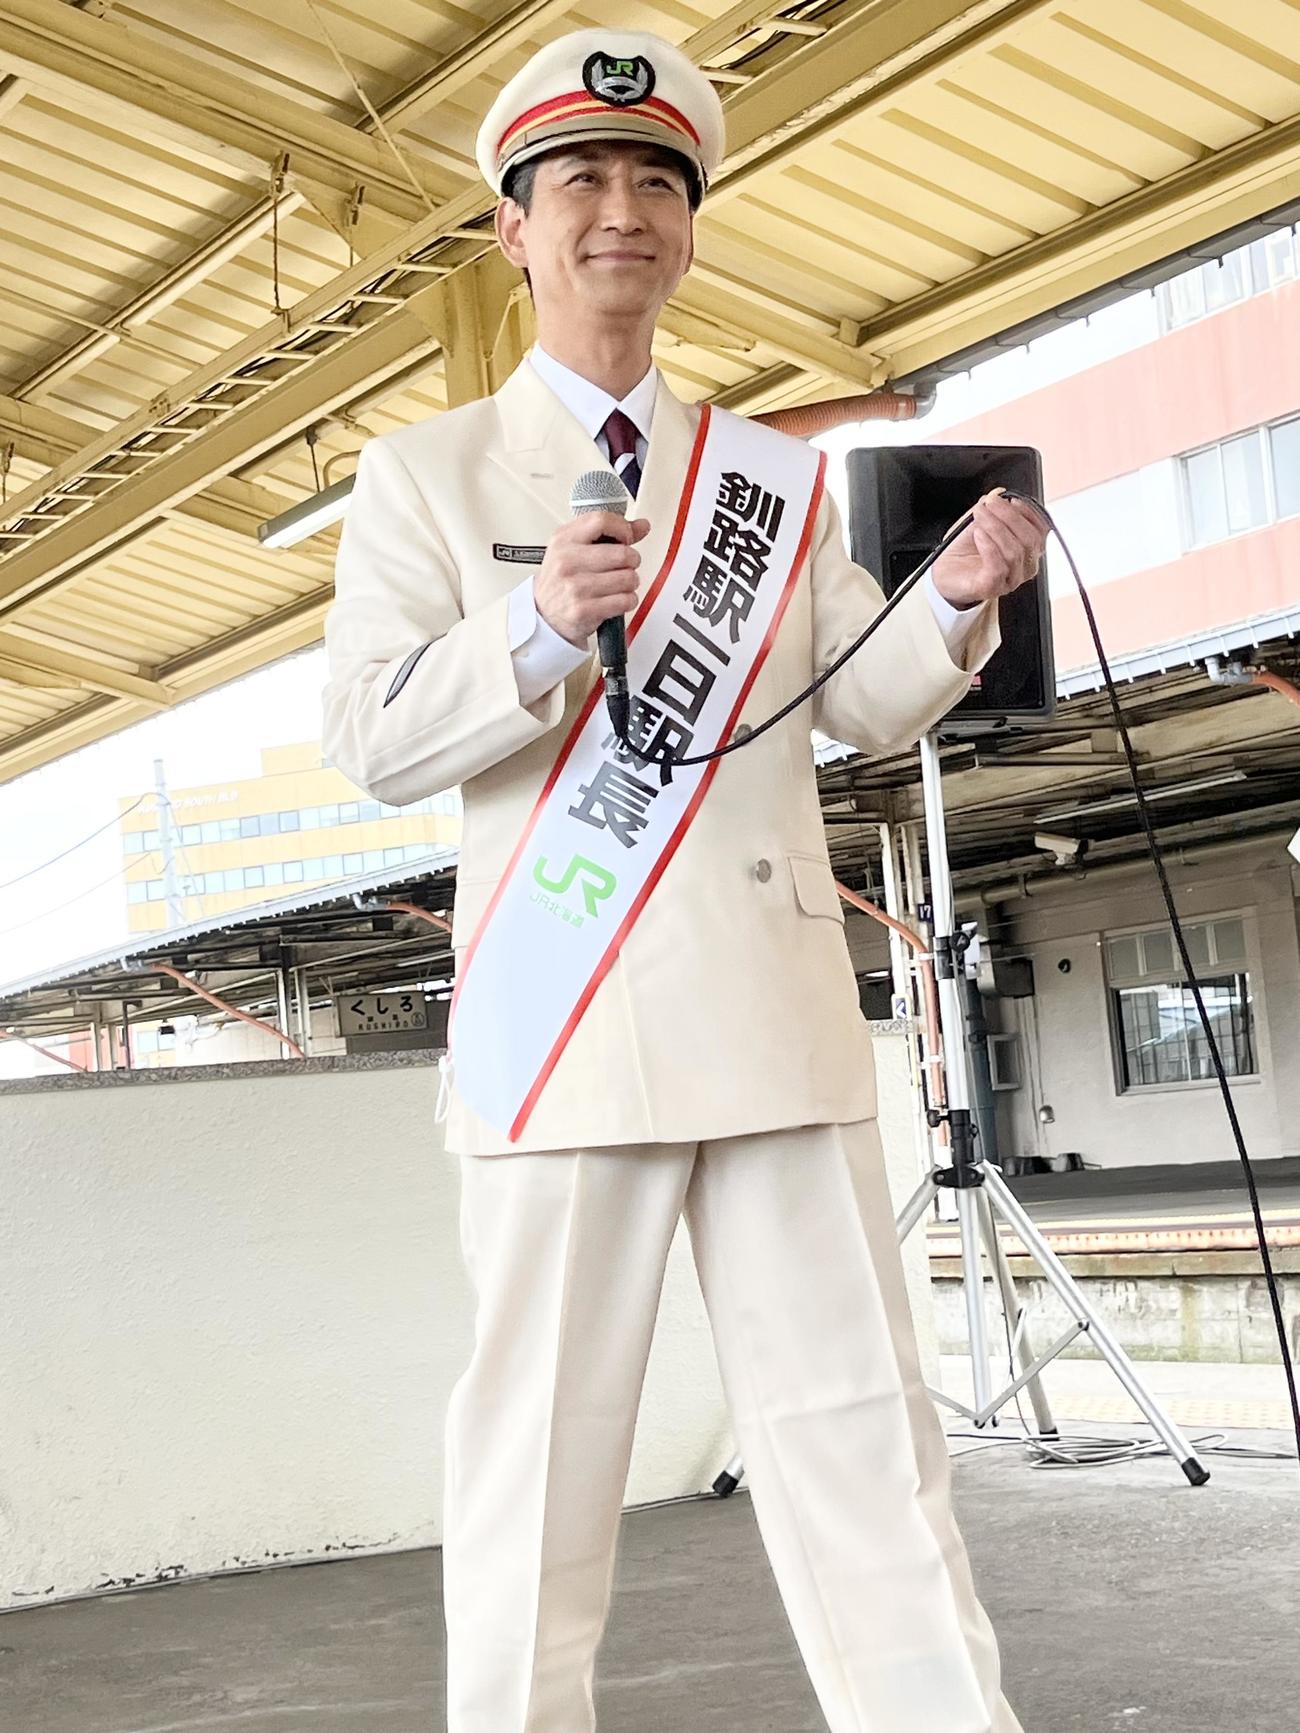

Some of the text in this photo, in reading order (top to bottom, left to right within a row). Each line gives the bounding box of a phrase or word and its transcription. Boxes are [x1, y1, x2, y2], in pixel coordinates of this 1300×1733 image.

[606, 60, 634, 76] JR
[567, 471, 785, 848] 釧路駅一日駅長
[533, 854, 617, 918] JR
[350, 995, 413, 1015] くしろ
